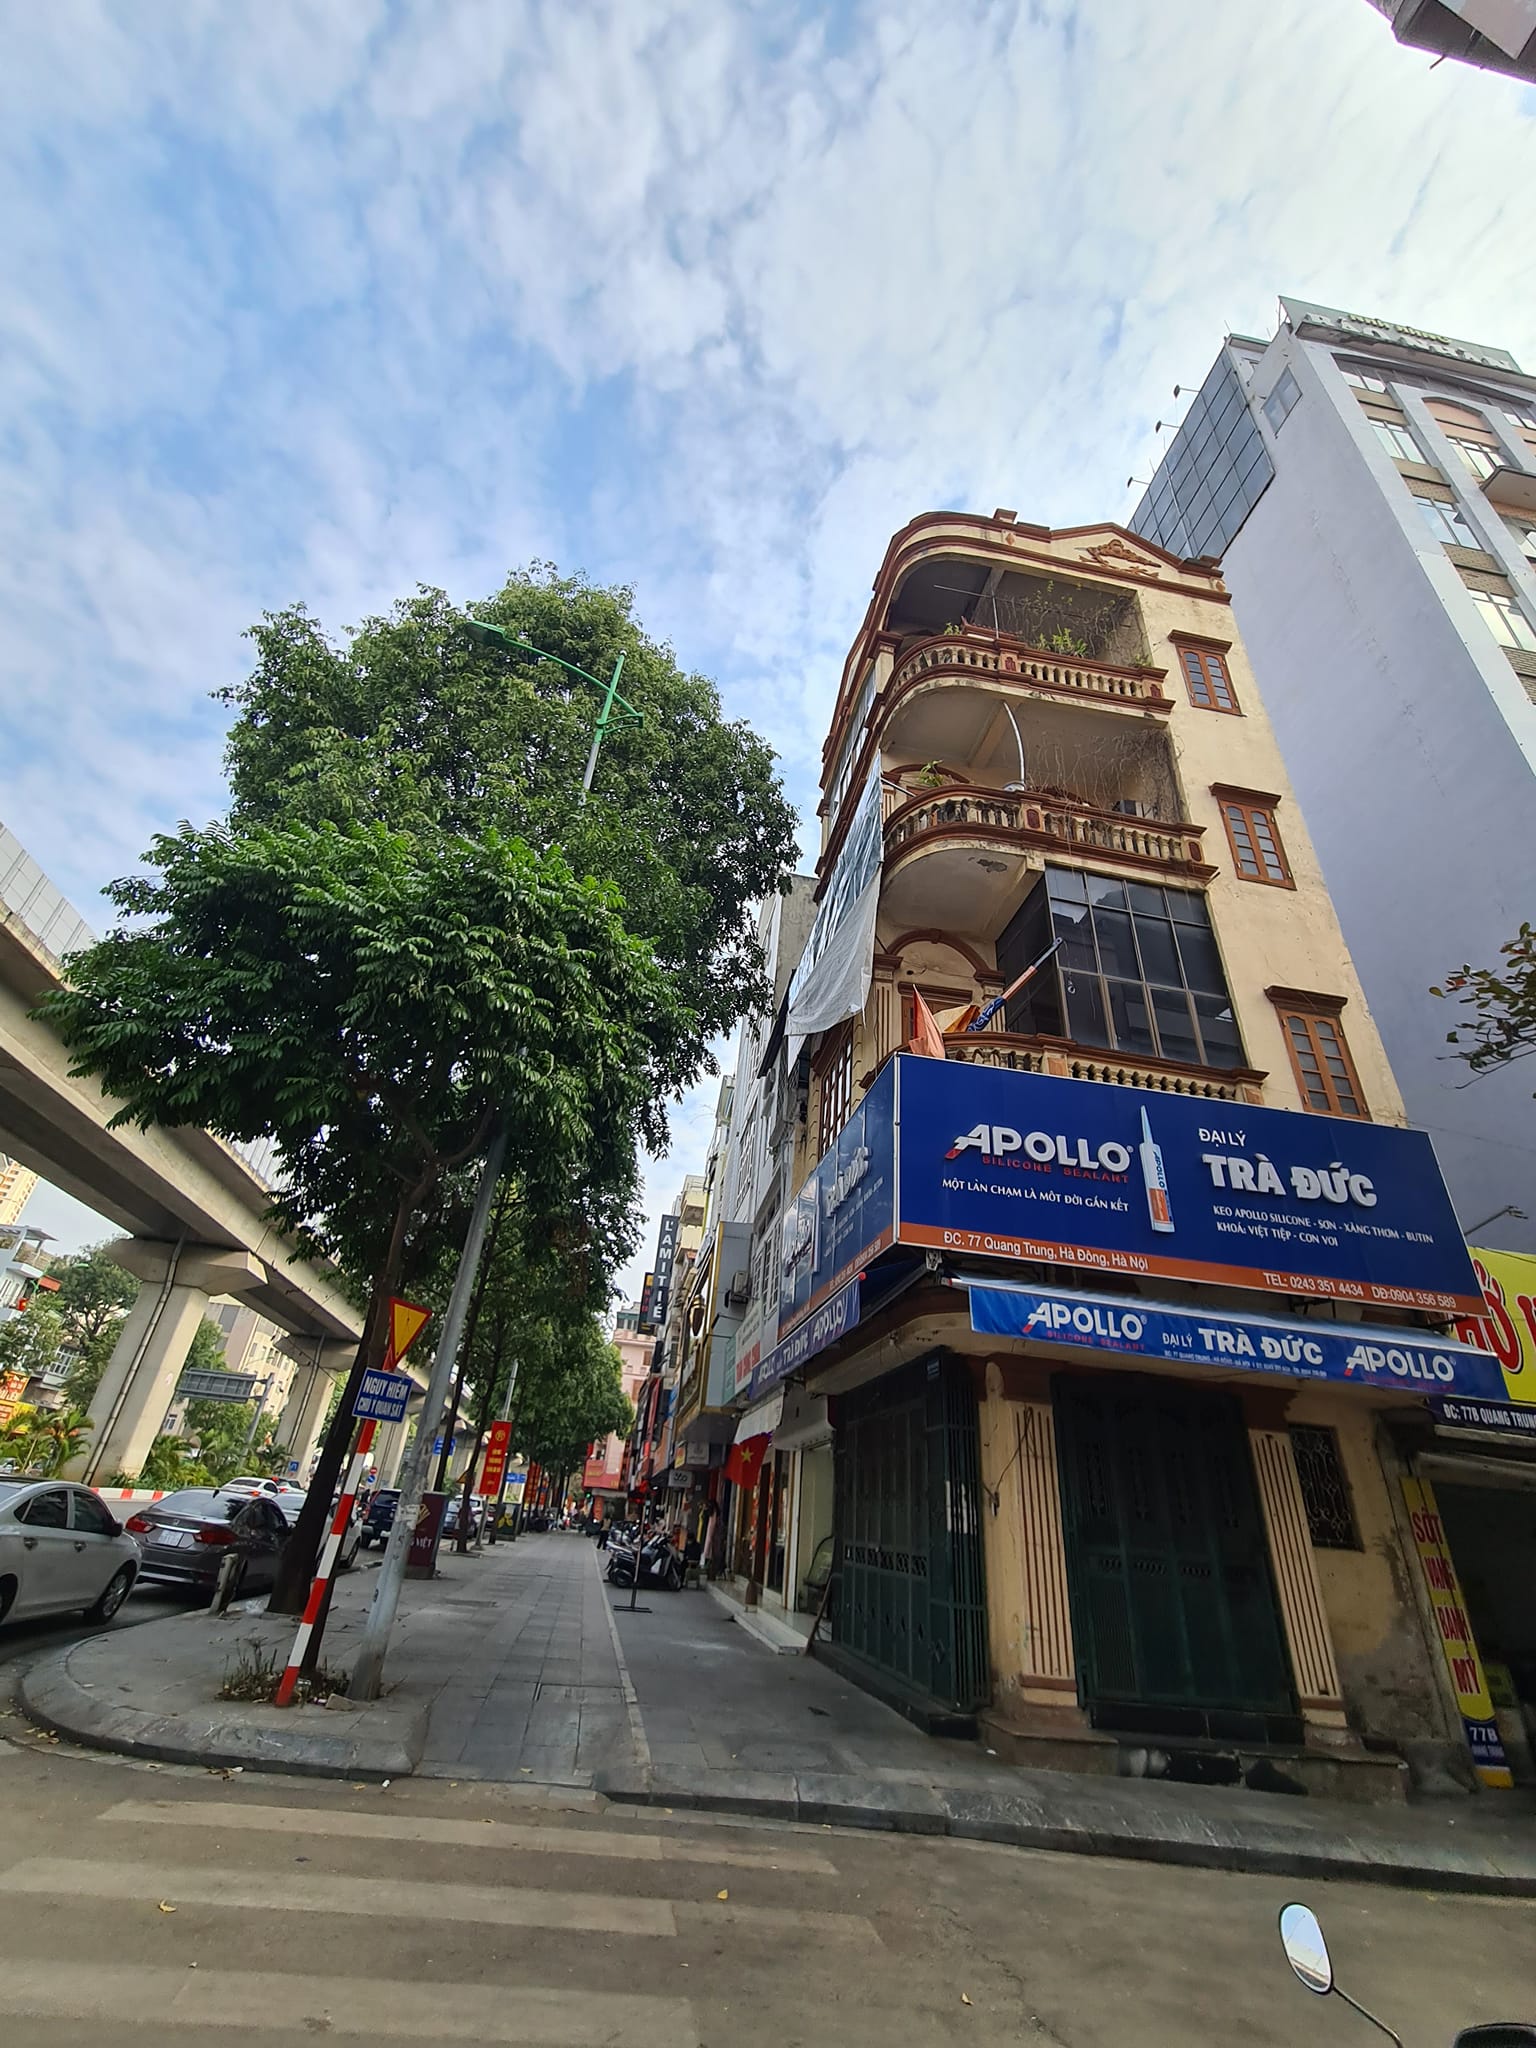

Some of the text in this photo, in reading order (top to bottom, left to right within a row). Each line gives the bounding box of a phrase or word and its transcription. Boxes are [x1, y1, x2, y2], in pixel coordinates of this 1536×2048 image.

[945, 1123, 1131, 1172] APOLLO
[1199, 1128, 1247, 1148] ĐẠI LÝ
[982, 1156, 1129, 1184] SILICONE SEALANT
[1202, 1153, 1378, 1207] TRÀ ĐỨC
[942, 1177, 964, 1192] MỘT
[990, 1184, 1022, 1198] CHẠM
[1024, 1187, 1037, 1200] LÀ
[1064, 1193, 1083, 1206] ĐỜI
[1213, 1205, 1233, 1216] KEO
[1235, 1207, 1268, 1221] APOLLO
[1269, 1212, 1312, 1227] SILICONE
[1318, 1219, 1337, 1231] SƠN
[1405, 1231, 1434, 1244] BUTIN
[1248, 1224, 1268, 1239] VIỆT
[1271, 1226, 1291, 1241] TIỆP
[1299, 1232, 1320, 1244] CON
[1321, 1235, 1338, 1247] VOI
[944, 1231, 965, 1246] ĐC.
[967, 1234, 981, 1247] 77
[984, 1236, 1021, 1256] Quang
[1023, 1241, 1057, 1260] Trung,
[1060, 1246, 1075, 1260] Hà
[1077, 1248, 1110, 1267] Đông,
[1112, 1252, 1128, 1268] Hà
[1262, 1272, 1287, 1287] TEL:
[1290, 1275, 1315, 1291] 0243
[1317, 1279, 1336, 1293] 351
[1338, 1281, 1364, 1297] 4434
[1416, 1291, 1436, 1305] 356
[1437, 1295, 1457, 1308] 589
[1022, 1301, 1143, 1341] APOLLO
[1162, 1328, 1324, 1365] ĐẠI LÝ TRÀ ĐỨC
[1344, 1344, 1455, 1382] APOLLO
[363, 1375, 388, 1397] NGUY
[1443, 1403, 1460, 1420] ĐC:
[1461, 1405, 1480, 1422] 77B
[1480, 1407, 1511, 1426] QUANG
[1469, 1727, 1498, 1743] 77B
